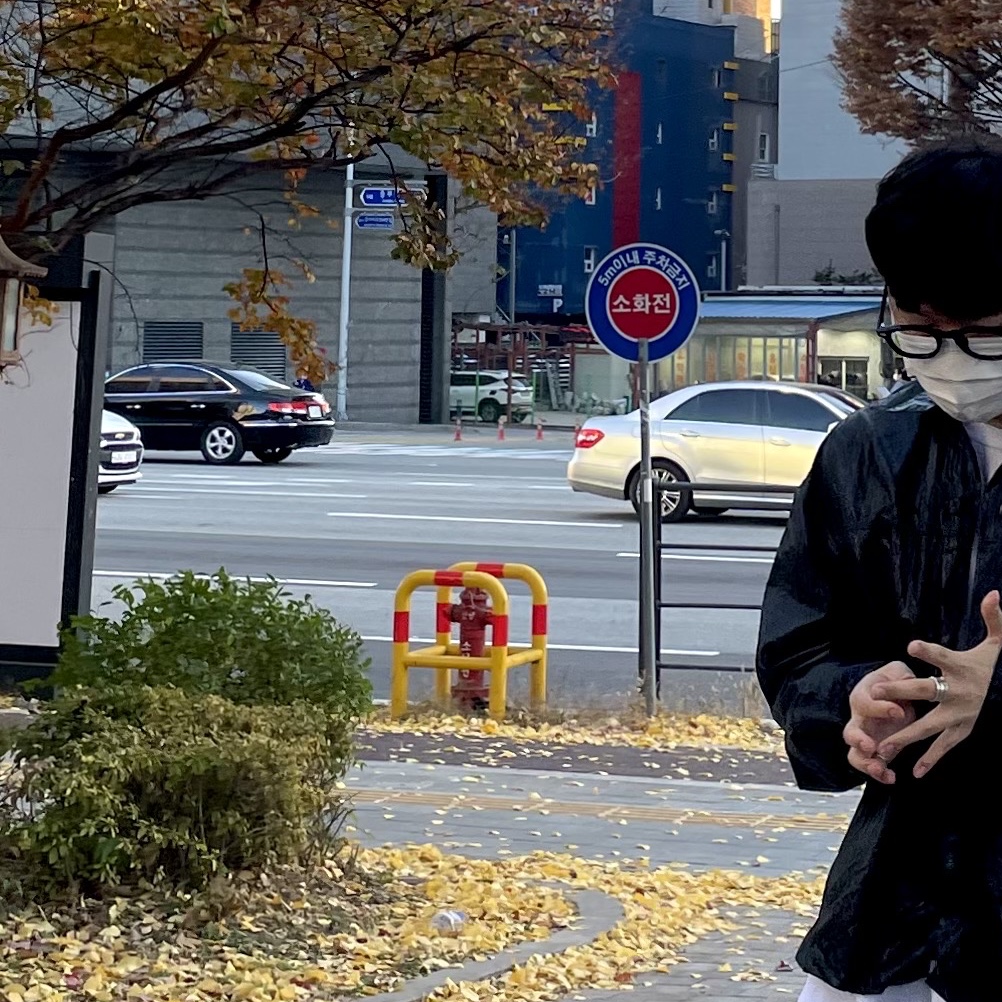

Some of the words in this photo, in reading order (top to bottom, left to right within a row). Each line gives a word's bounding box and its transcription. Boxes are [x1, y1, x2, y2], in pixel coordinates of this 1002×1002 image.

[598, 250, 640, 286] 5m이내
[643, 250, 690, 290] 주차금지
[611, 293, 671, 314] 소화전
